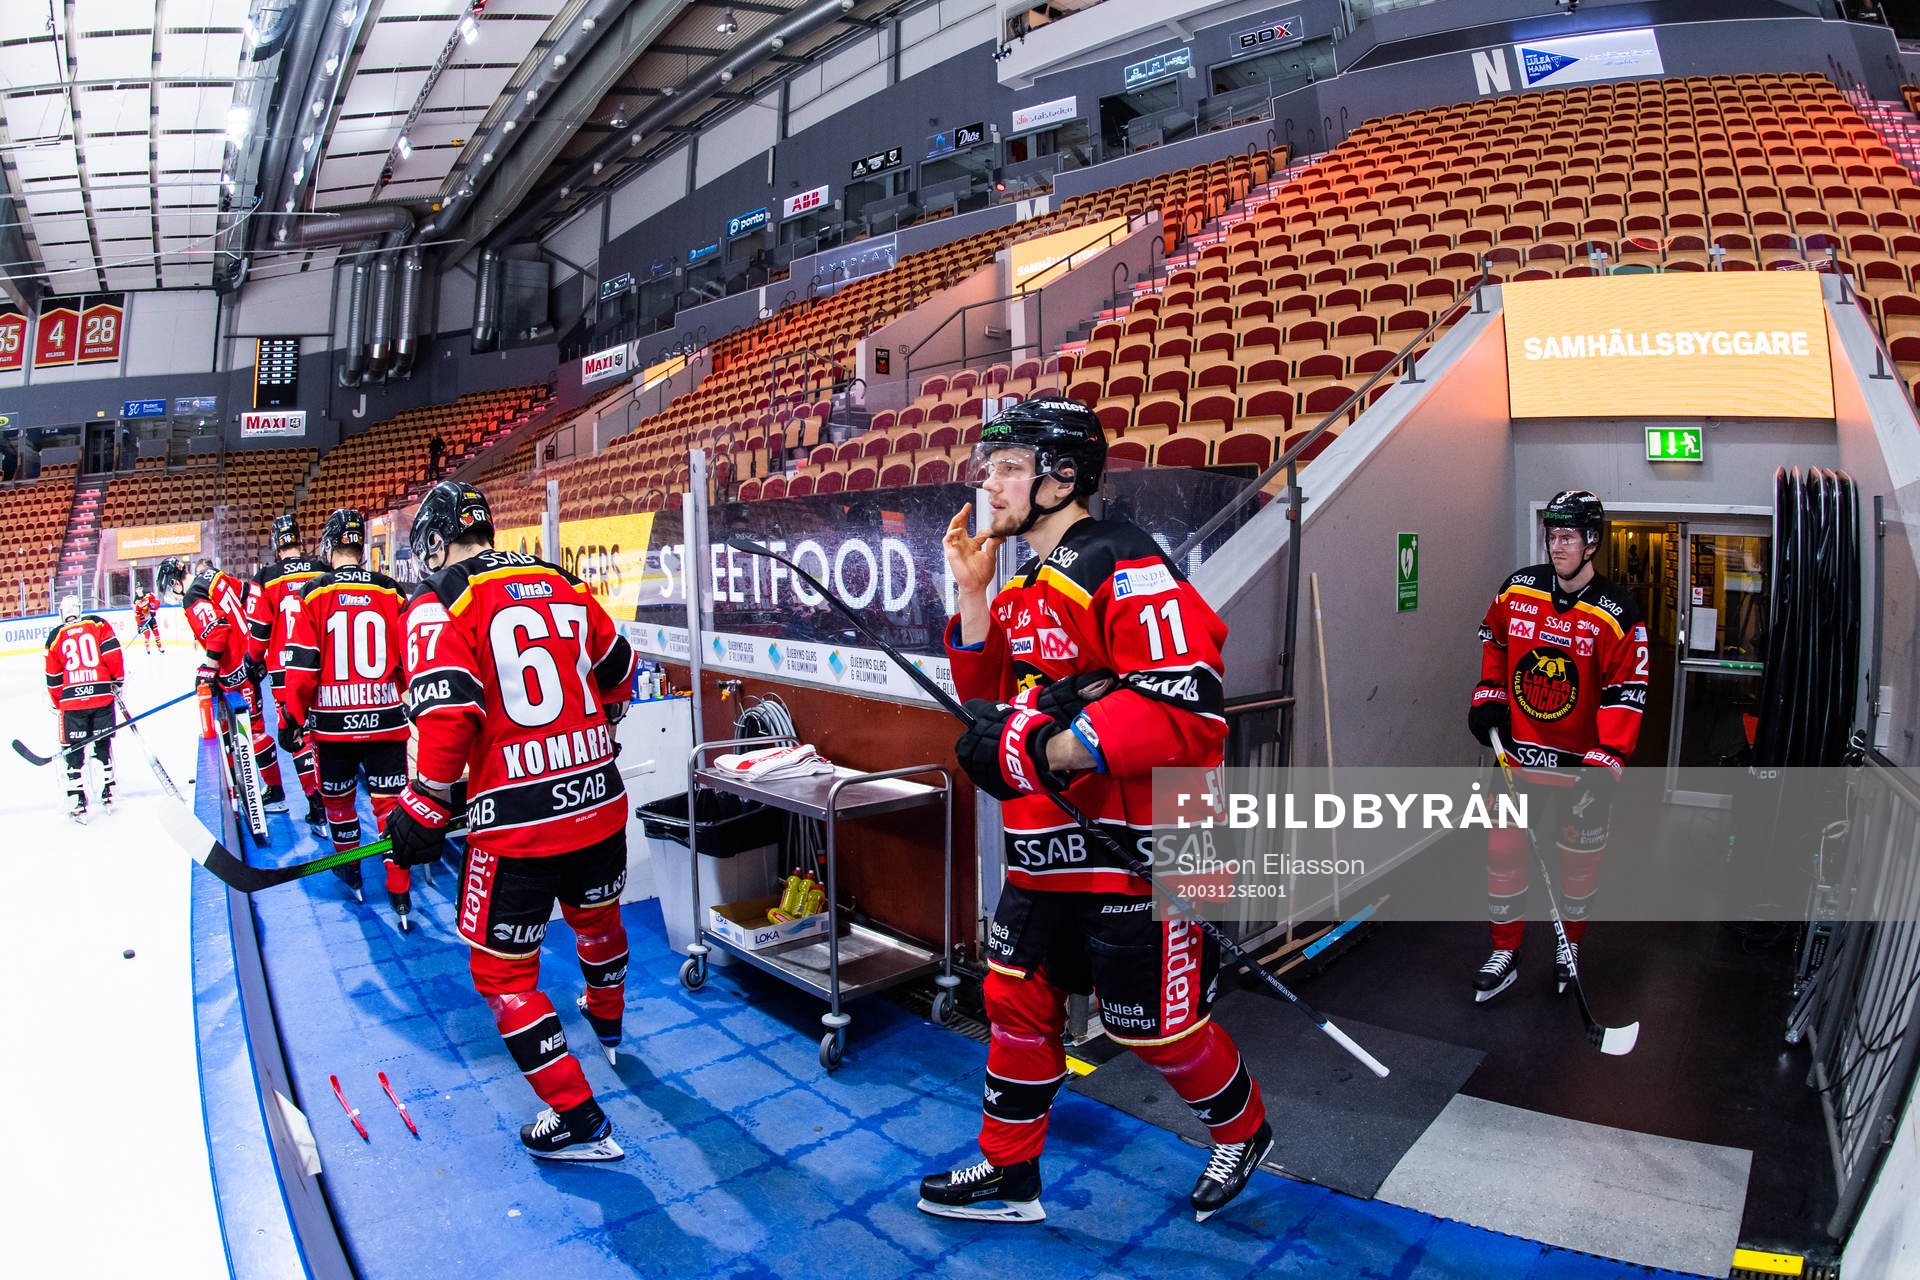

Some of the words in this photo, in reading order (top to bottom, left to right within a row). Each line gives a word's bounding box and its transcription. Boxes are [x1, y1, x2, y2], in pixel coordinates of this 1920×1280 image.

[1240, 22, 1293, 49] BDX
[1472, 48, 1512, 95] N
[792, 191, 820, 212] ABB
[48, 319, 64, 348] 4
[85, 316, 116, 343] 28
[1524, 328, 1811, 360] SAMHÄLLSBYGGARE
[585, 355, 613, 375] MAXI
[246, 415, 287, 430] MAXI
[473, 510, 486, 521] 67
[348, 533, 359, 542] 10
[284, 562, 311, 574] SSAB
[479, 552, 535, 567] SSAB
[335, 571, 371, 582] SSAB
[505, 581, 553, 600] Vinab
[1515, 602, 1539, 615] LKAB
[1139, 598, 1189, 661] 11
[1544, 616, 1572, 633] SSAB
[327, 610, 387, 682] 10
[407, 623, 444, 673] 67
[1540, 633, 1570, 646] SCANIA
[62, 633, 100, 671] 30
[490, 602, 599, 729] 67
[850, 654, 872, 669] ÖJEBYNS
[872, 659, 887, 672] GLAS
[935, 664, 951, 681] ÖJEB
[855, 671, 888, 685] ALUMINIUM
[74, 685, 95, 697] SSAB
[317, 682, 400, 707] EMANUELSSN
[343, 713, 380, 730] SSAB
[1517, 747, 1559, 769] SSAB
[240, 744, 261, 831] NORRMASKINER
[379, 774, 407, 788] LKAB
[552, 773, 606, 812] SSAB
[1013, 834, 1087, 866] SSAB
[1136, 829, 1217, 868] SSAB
[755, 930, 780, 945] LOKA
[1101, 998, 1144, 1016] Luleå
